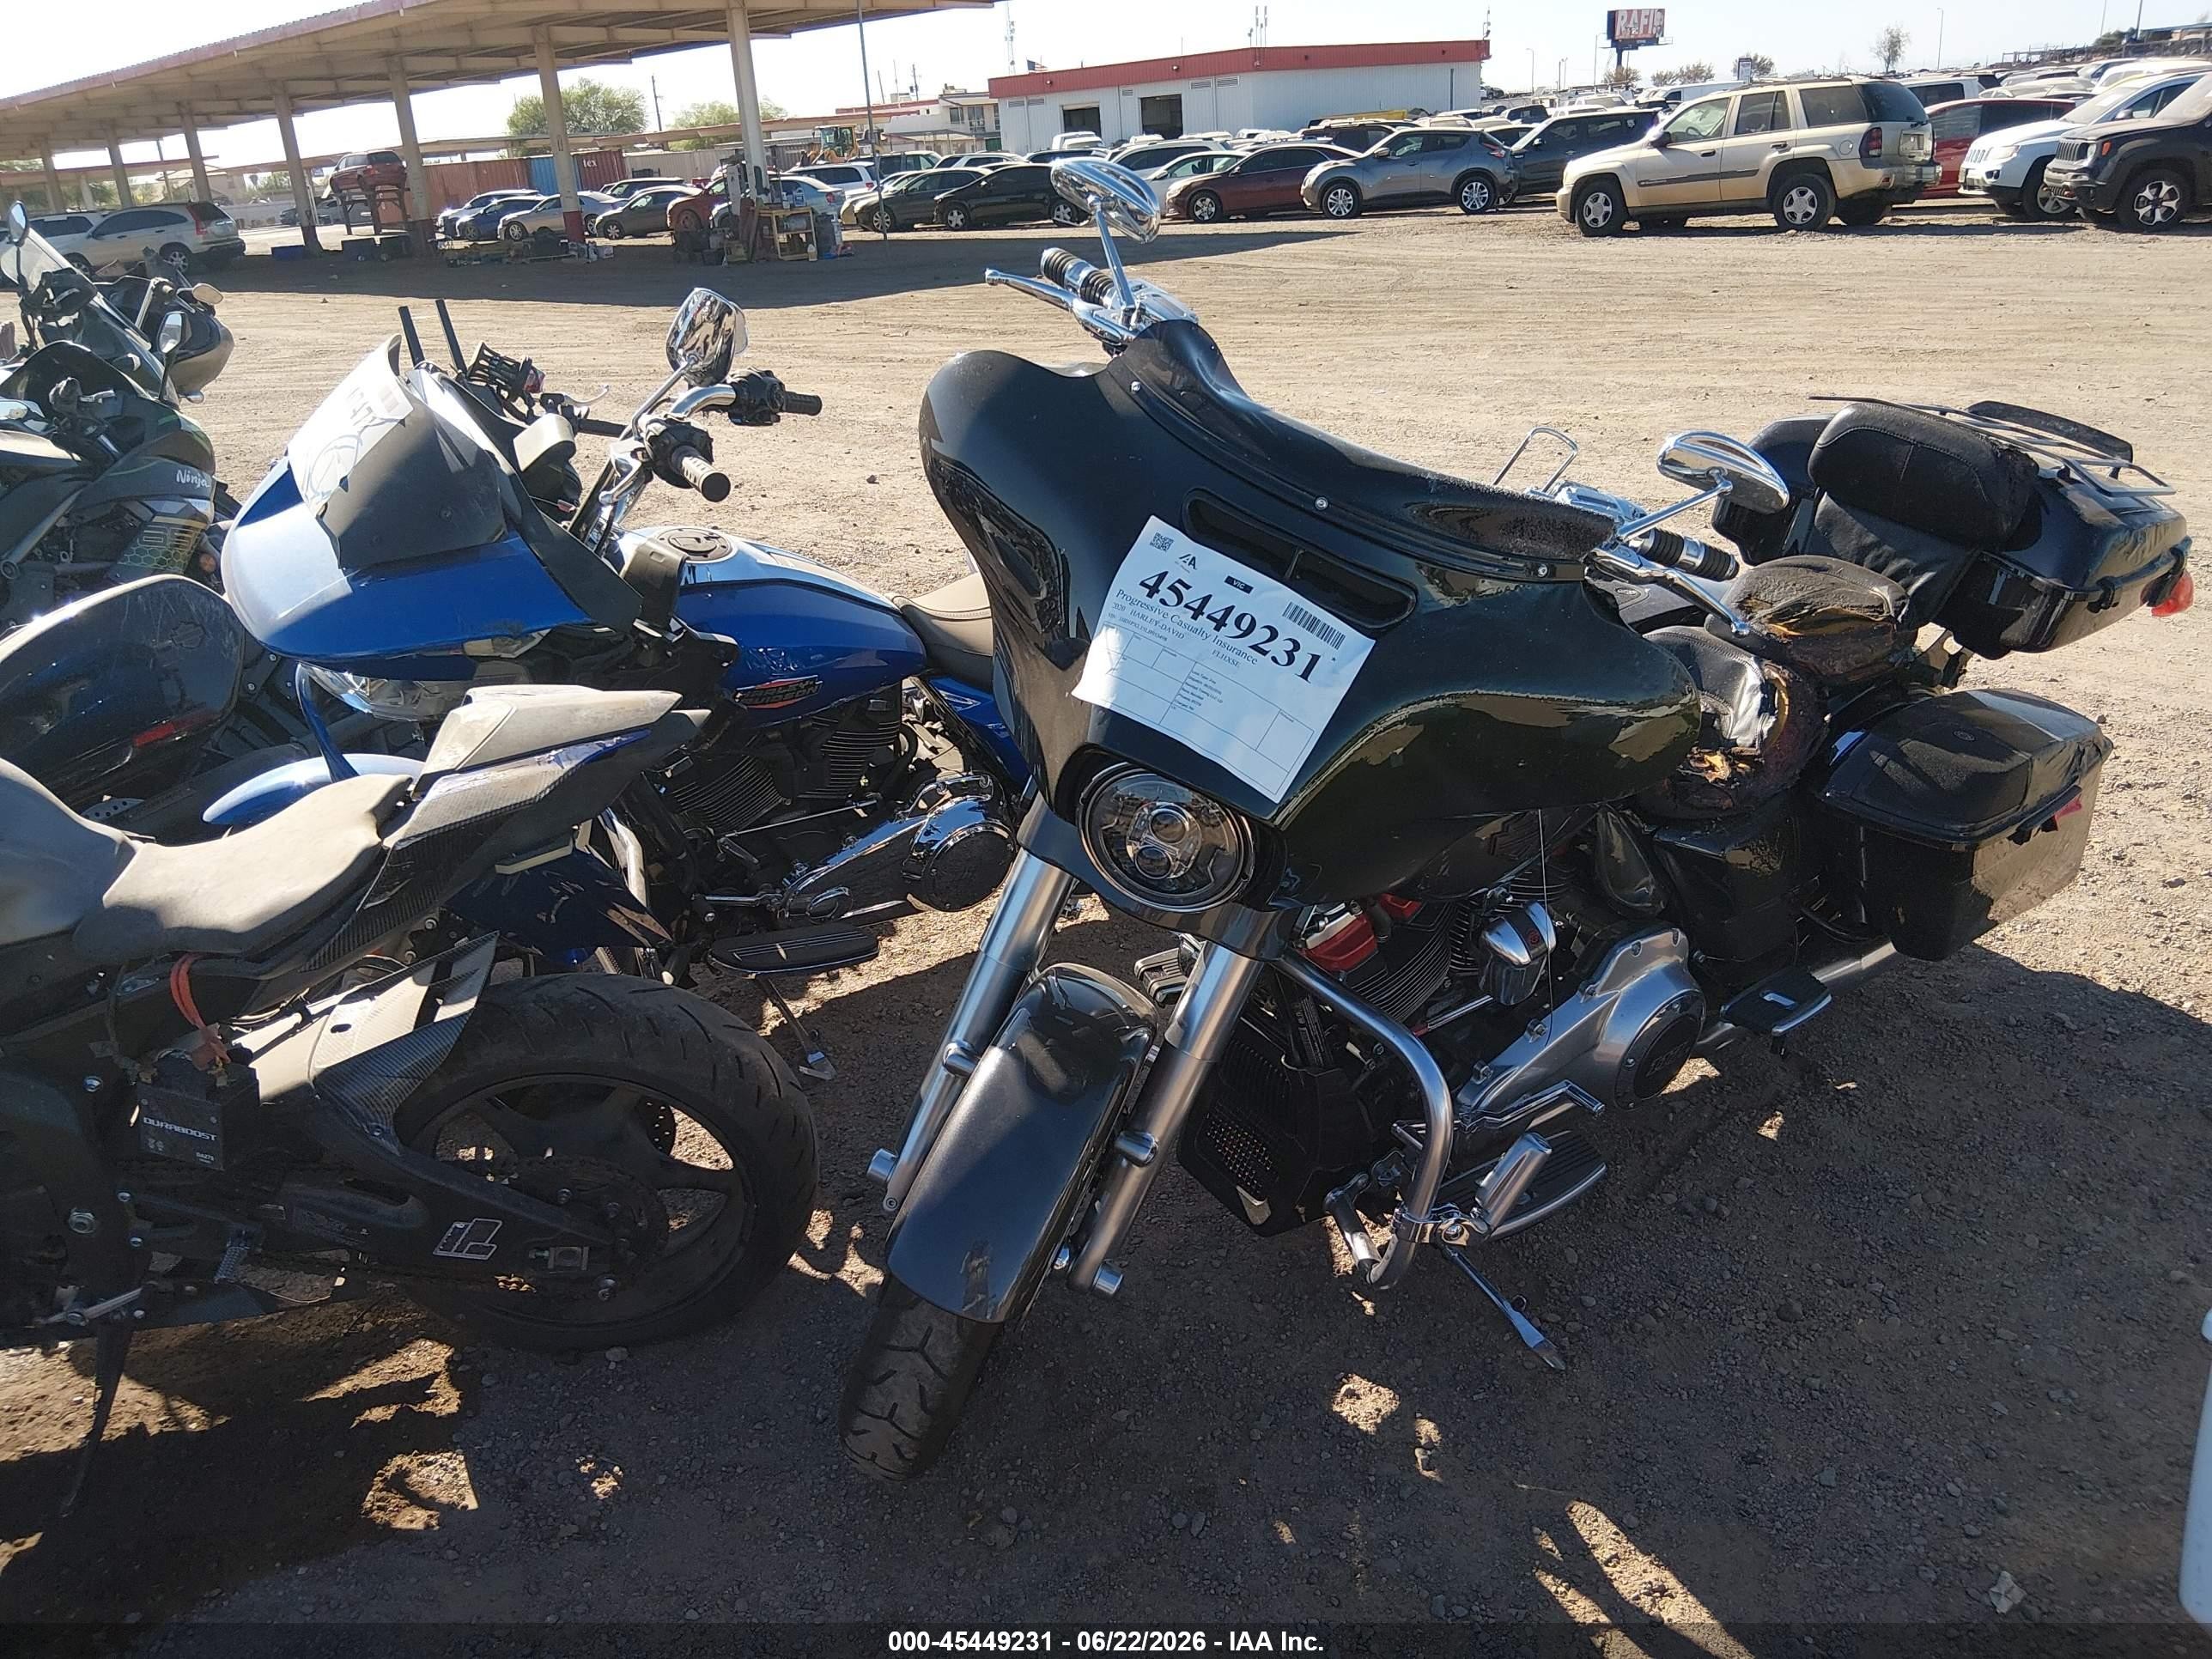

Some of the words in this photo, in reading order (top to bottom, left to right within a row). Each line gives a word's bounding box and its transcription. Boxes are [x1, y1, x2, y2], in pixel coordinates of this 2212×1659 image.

[176, 469, 210, 489] Ninja
[1232, 580, 1246, 590] VIC
[1113, 602, 1126, 611] 2020
[1130, 609, 1185, 640] HARLEY-DAVID
[1116, 589, 1169, 618] Progressive
[1170, 614, 1212, 641] Casualty
[1212, 635, 1258, 665] Insurance
[1139, 570, 1322, 684] 45449231
[143, 1116, 217, 1141] DURABOOST
